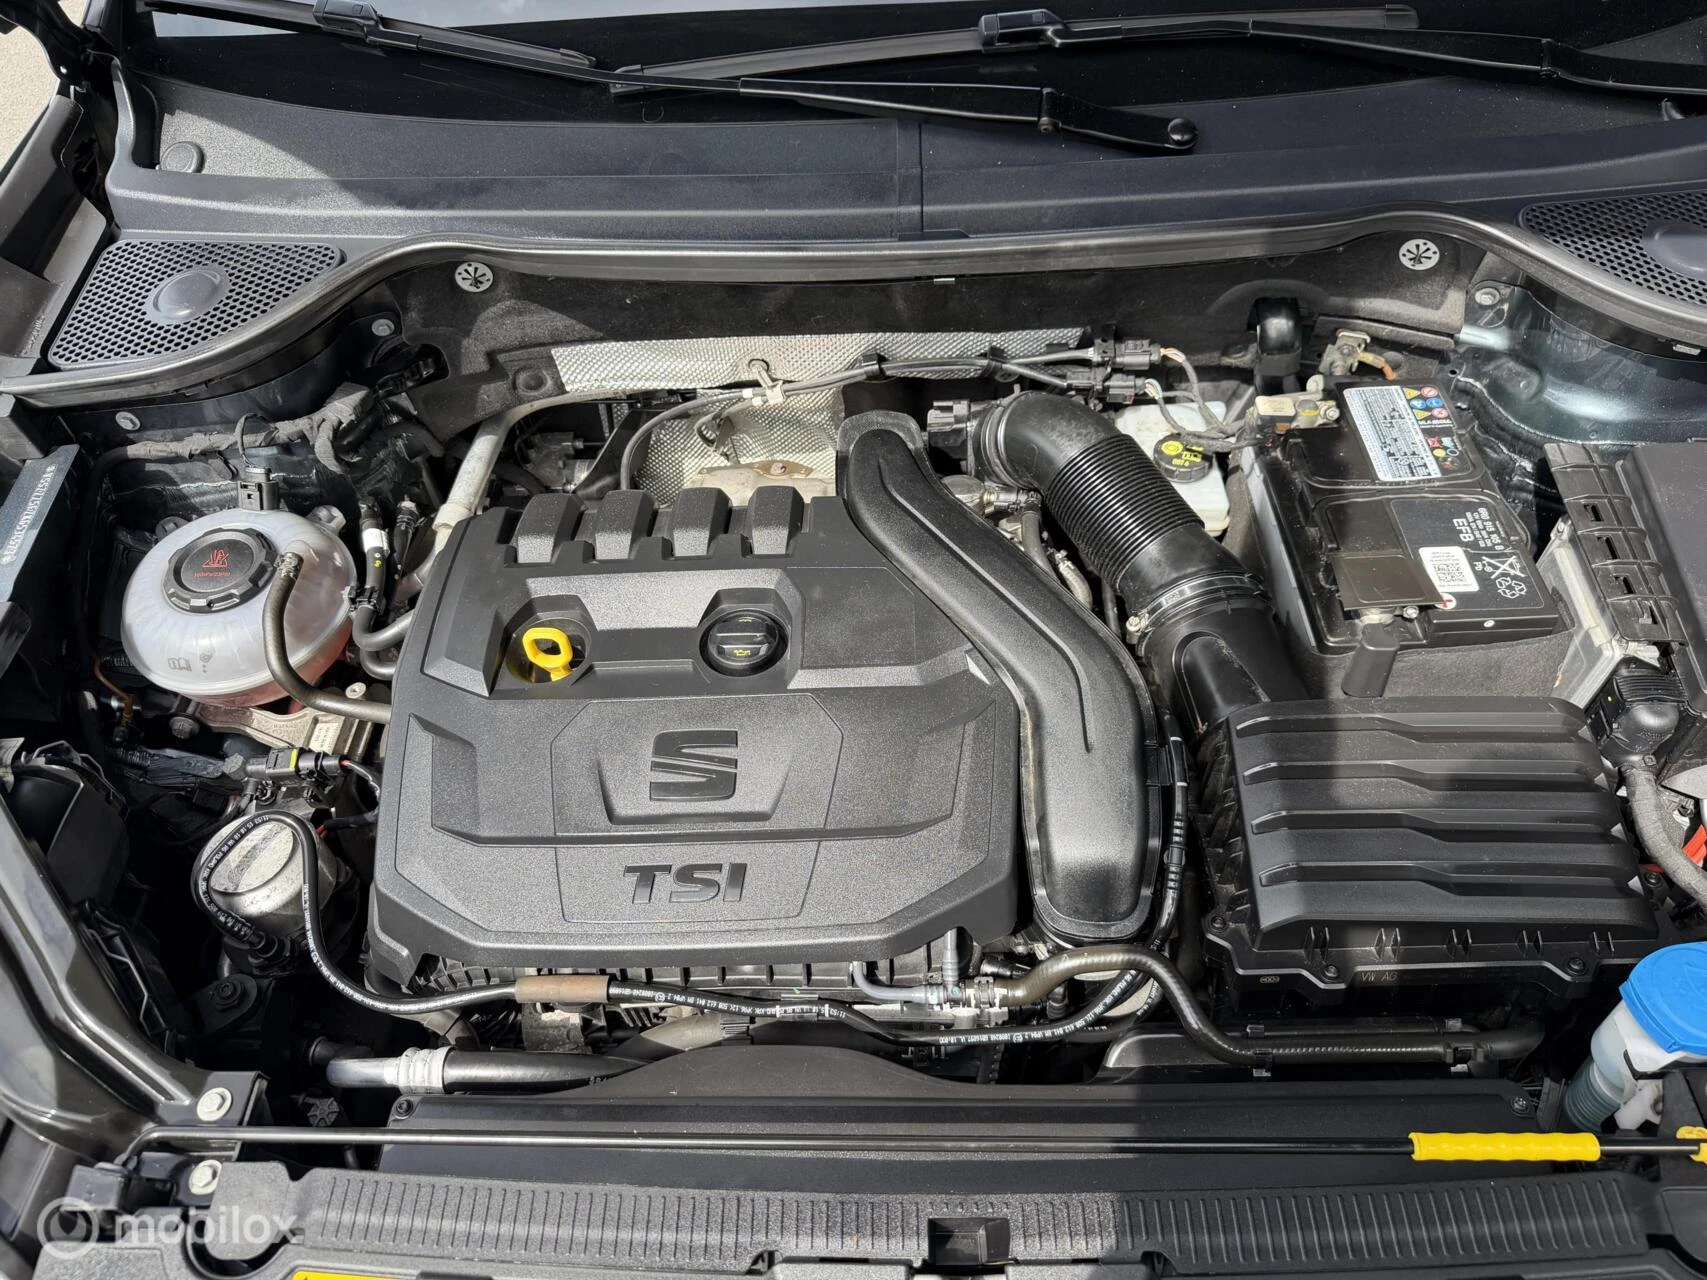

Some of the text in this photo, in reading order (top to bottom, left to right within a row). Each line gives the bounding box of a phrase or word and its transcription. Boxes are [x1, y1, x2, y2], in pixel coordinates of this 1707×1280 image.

[1453, 518, 1474, 542] EFB
[623, 862, 748, 904] TSI
[1361, 971, 1398, 982] VW AG
